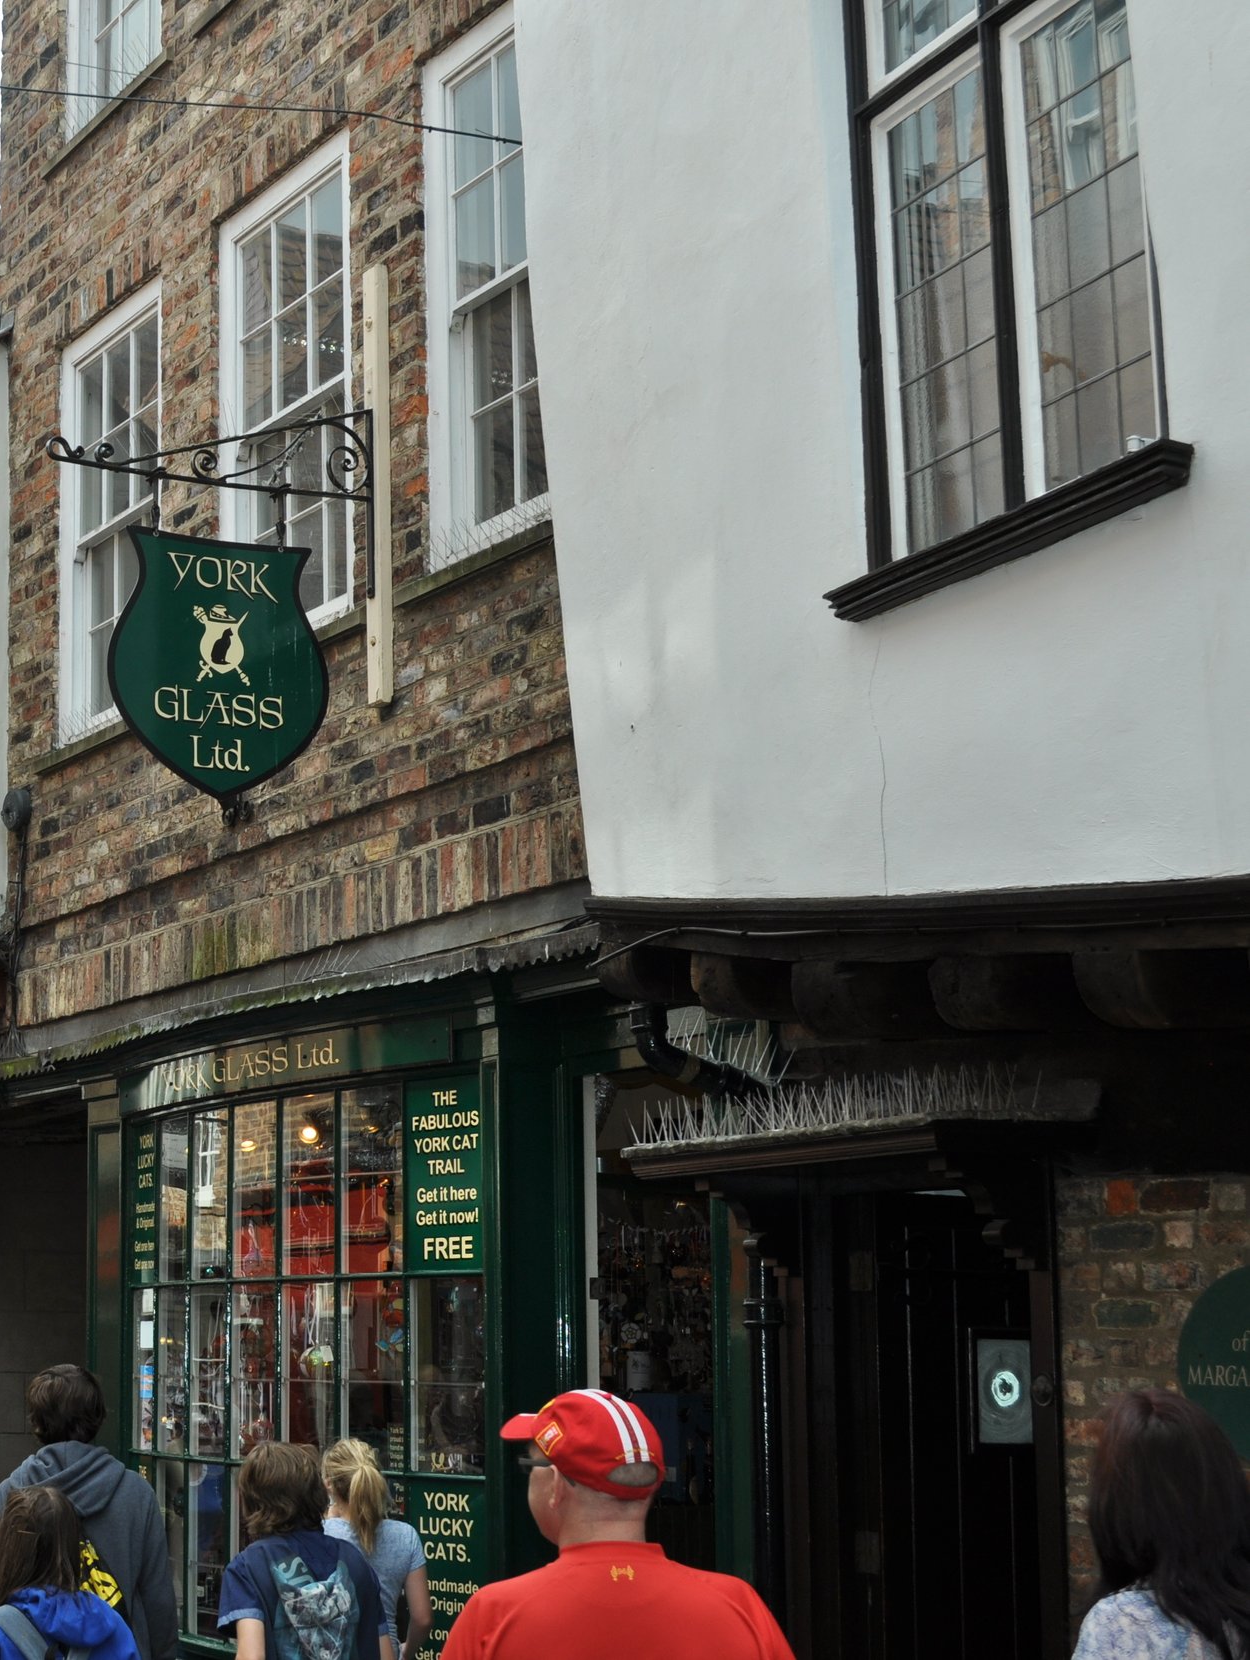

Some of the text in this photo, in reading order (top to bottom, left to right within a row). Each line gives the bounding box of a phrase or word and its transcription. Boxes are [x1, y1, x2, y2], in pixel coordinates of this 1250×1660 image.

[168, 552, 278, 604] YORK
[154, 684, 284, 730] GLASS
[190, 735, 250, 772] Ltd.
[160, 1038, 340, 1093] YORK GLASS Ltd.
[432, 1090, 457, 1107] THE
[412, 1110, 479, 1131] FABULOUS
[414, 1133, 479, 1153] YORK CAT
[428, 1158, 465, 1175] TRAIL
[417, 1185, 477, 1203] Get it here
[416, 1207, 479, 1226] Get it now!
[423, 1236, 474, 1261] FREE
[1232, 1330, 1250, 1351] of
[1187, 1365, 1250, 1387] MARGA
[423, 1491, 470, 1513] YORK
[419, 1516, 474, 1538] LUCKY
[424, 1541, 471, 1563] CATS.
[427, 1578, 479, 1595] andmade
[430, 1595, 465, 1616] Origin
